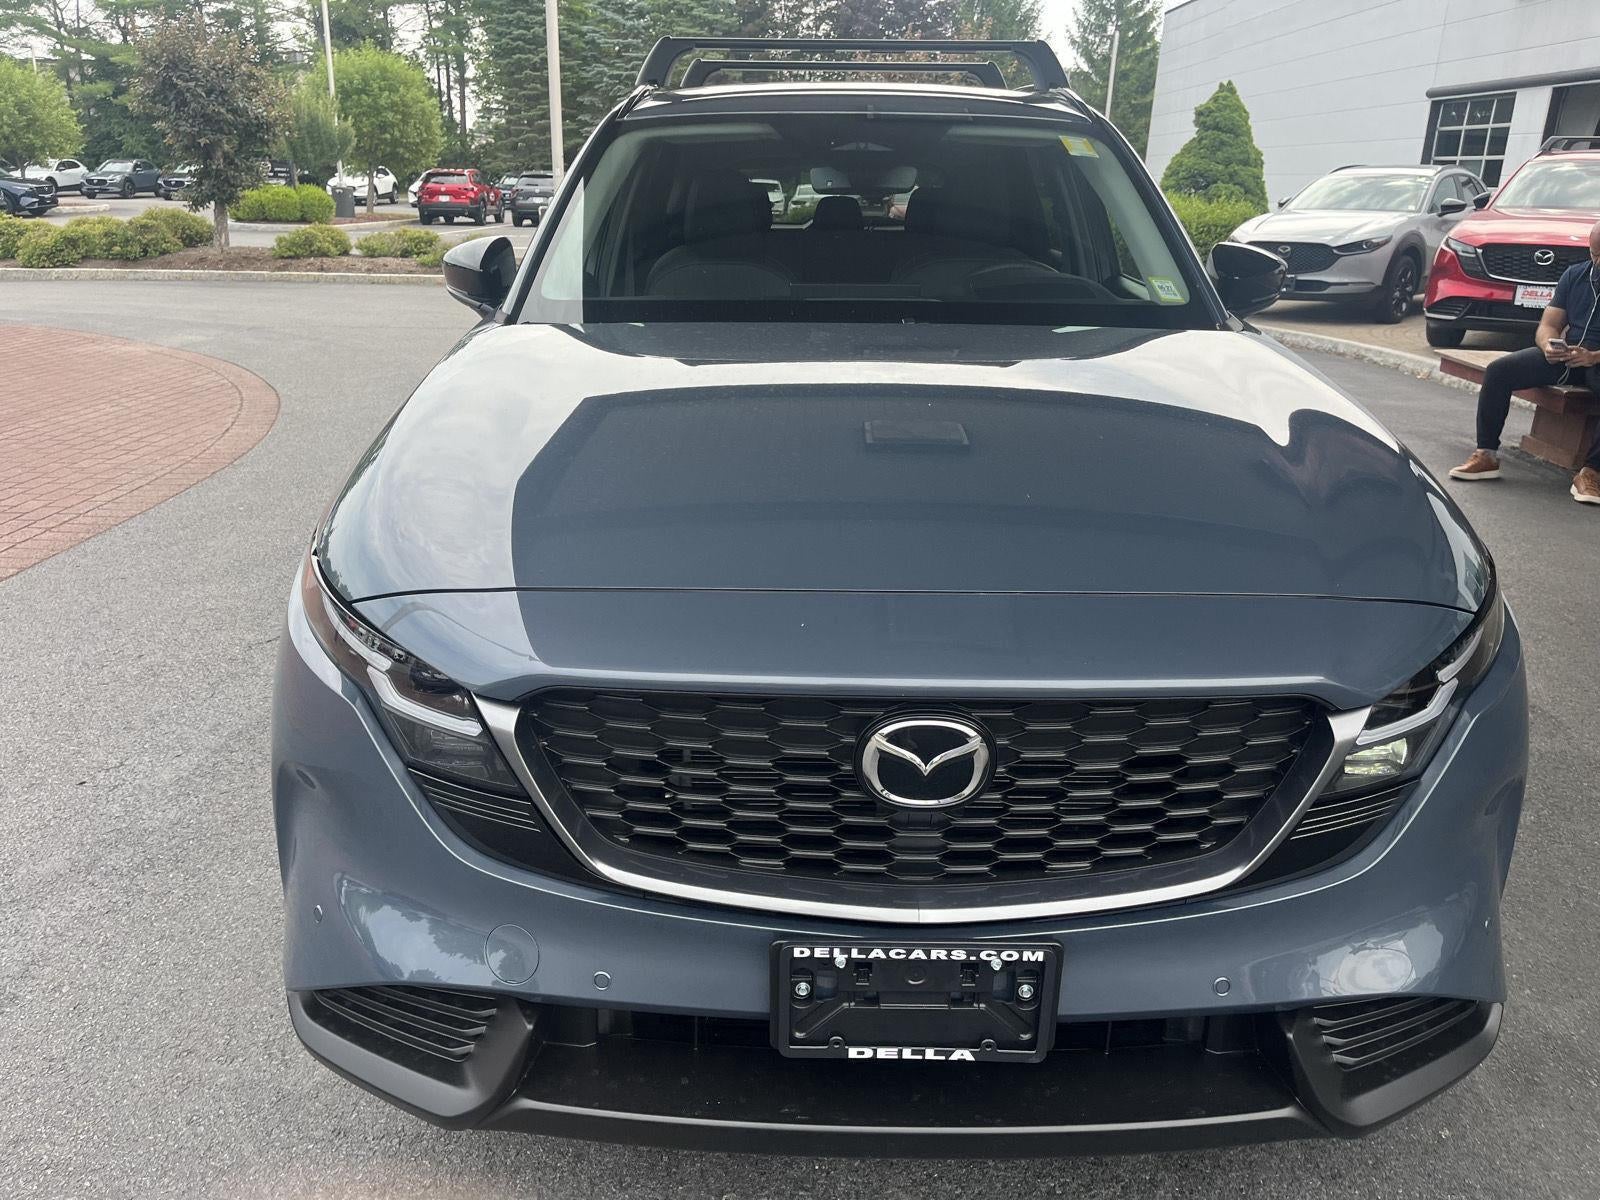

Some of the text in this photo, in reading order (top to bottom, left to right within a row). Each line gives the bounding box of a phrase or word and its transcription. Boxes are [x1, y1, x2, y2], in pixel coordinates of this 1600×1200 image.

[1522, 290, 1552, 298] DELLA
[793, 947, 1044, 962] DELLACARS.COM
[847, 1047, 976, 1061] DELLA
